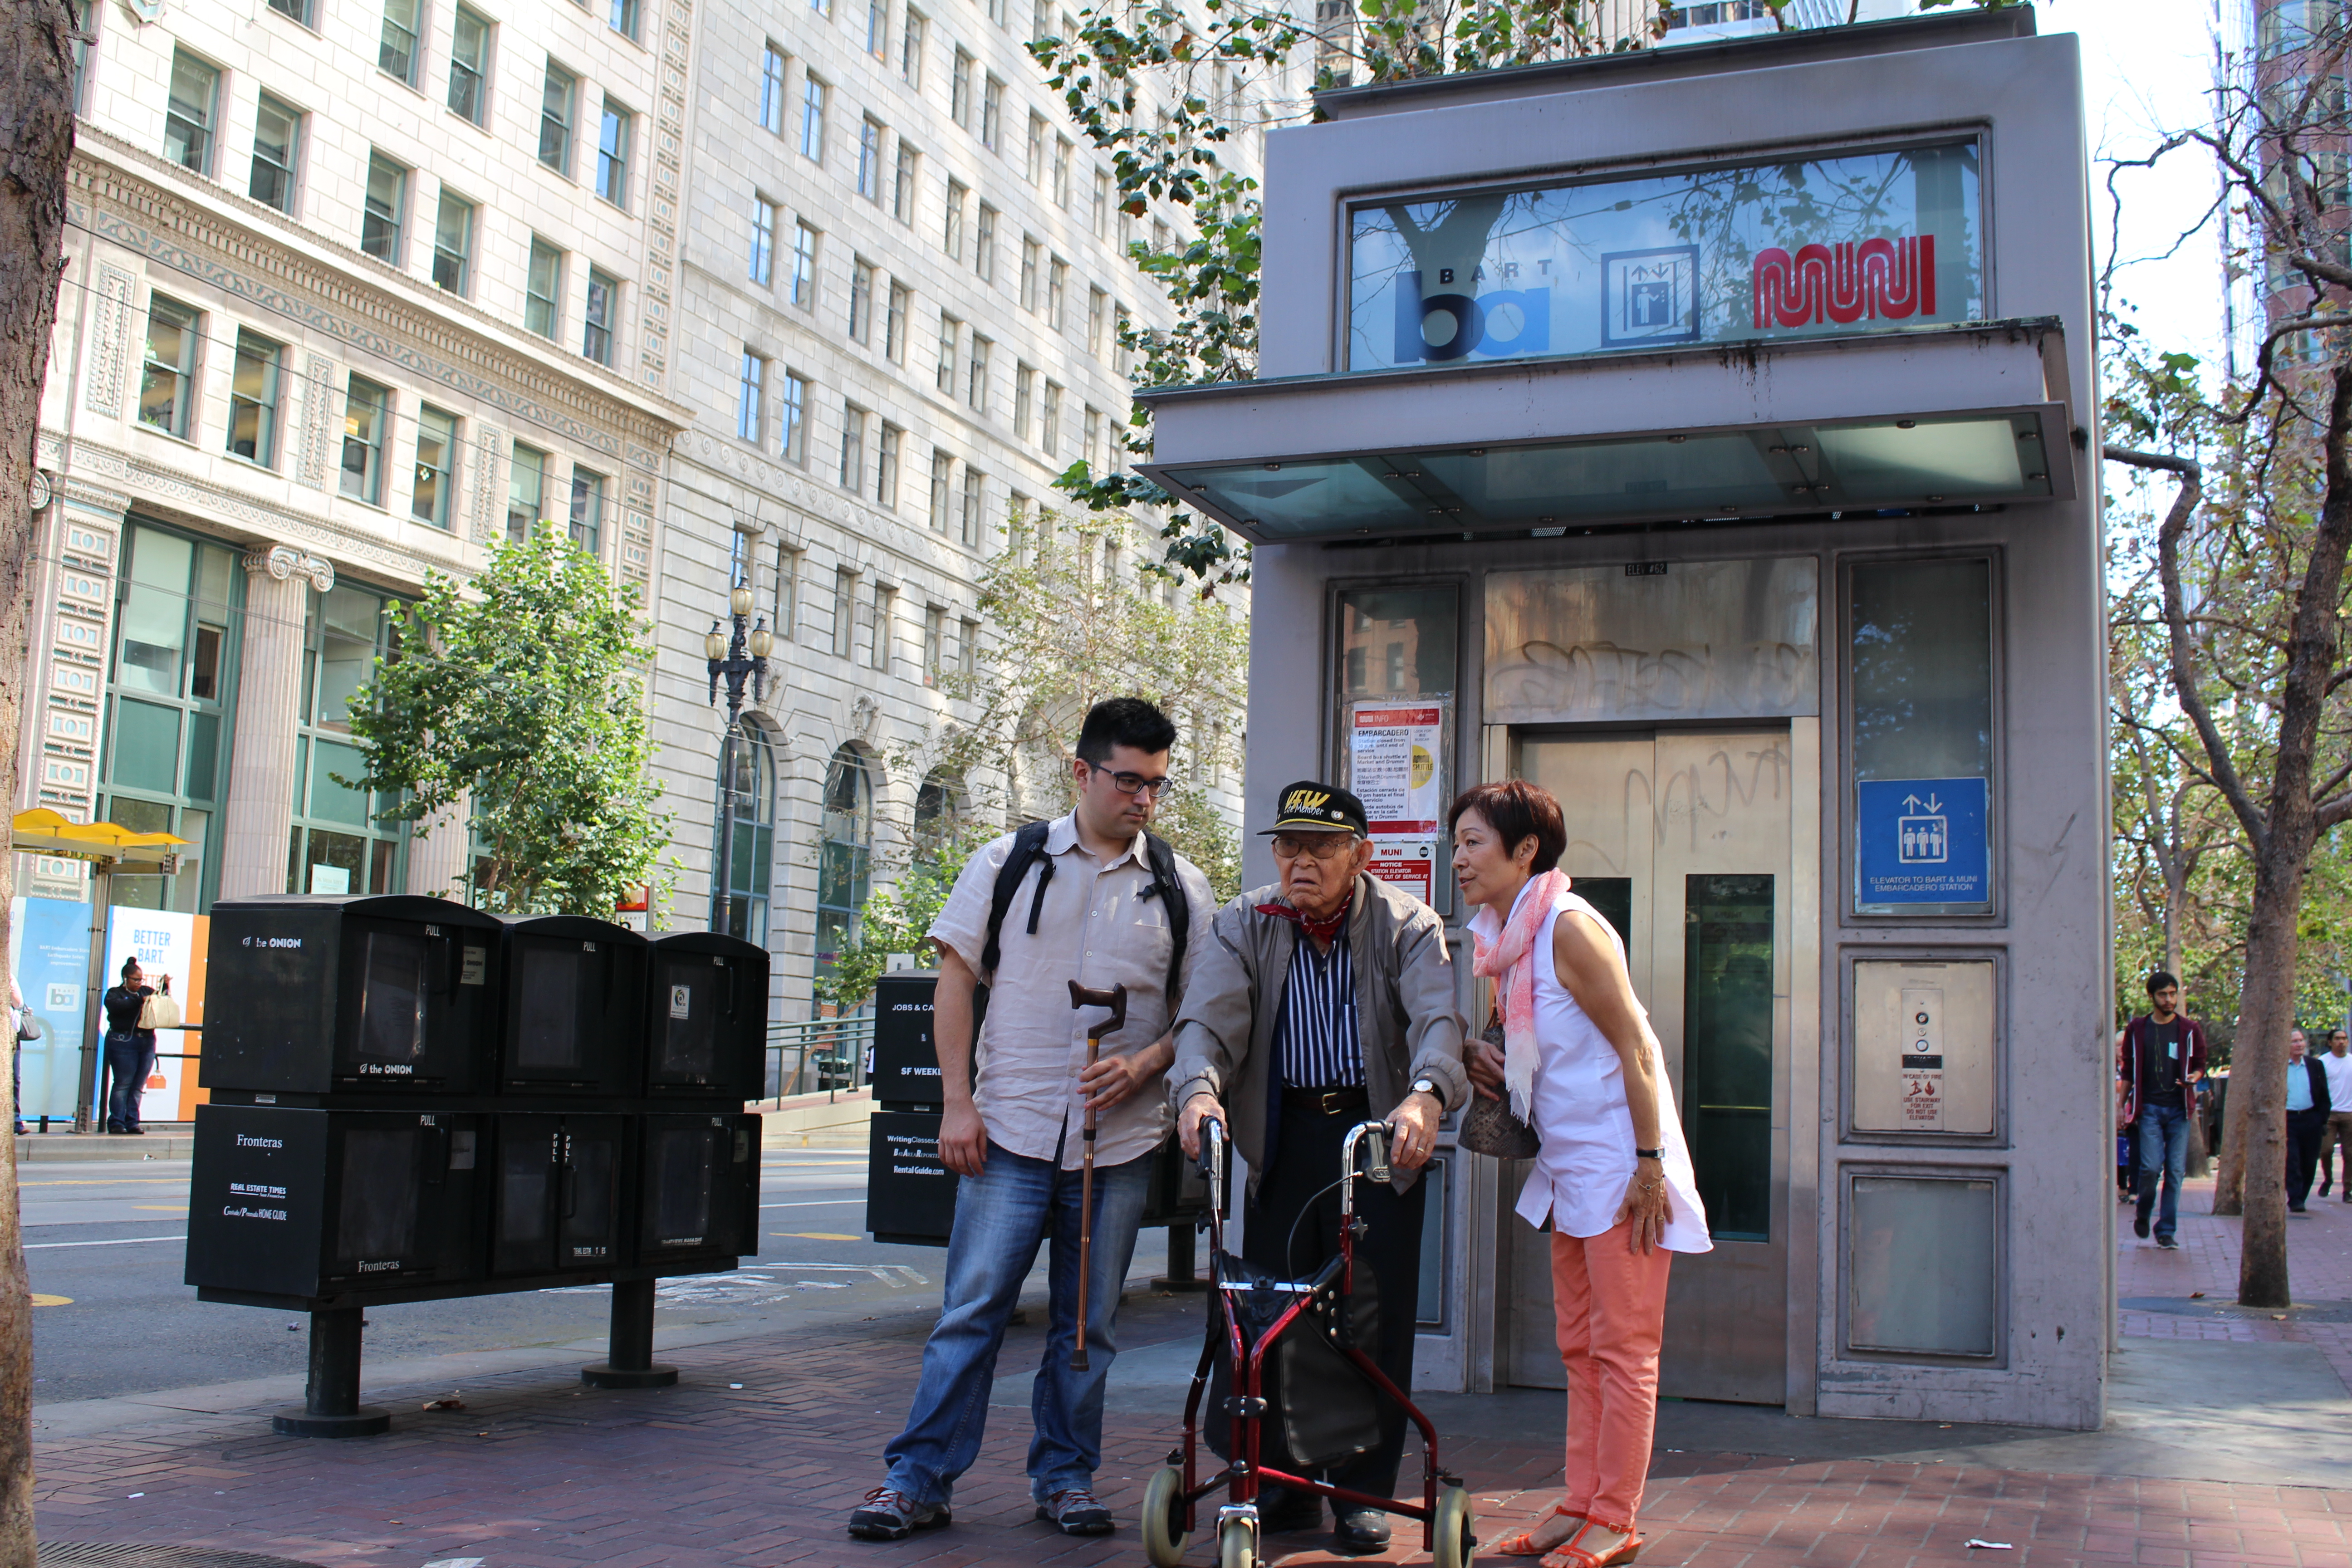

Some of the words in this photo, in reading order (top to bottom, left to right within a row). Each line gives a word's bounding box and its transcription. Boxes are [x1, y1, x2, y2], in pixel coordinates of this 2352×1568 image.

[1440, 259, 1552, 284] BART
[1628, 564, 1646, 575] ELEV
[1374, 715, 1389, 723] INFO
[1358, 729, 1409, 737] EMBARCADERO
[1285, 789, 1331, 810] VFW
[1294, 802, 1324, 815] Member
[1875, 884, 1937, 892] EMBARCADERO
[426, 925, 440, 936] PULL
[134, 929, 171, 946] BETTER
[269, 938, 301, 948] ONION
[583, 941, 596, 951] PULL
[137, 948, 164, 964] BART.
[713, 956, 724, 965] PULL
[369, 1063, 382, 1073] the
[385, 1064, 412, 1074] ONION
[901, 1067, 912, 1075] SF
[914, 1068, 942, 1076] WEEKL
[420, 1115, 435, 1126] PULL
[711, 1117, 722, 1126] PULL
[237, 1134, 283, 1148] Fronteras
[230, 1183, 245, 1191] REAL
[246, 1184, 268, 1193] ESTATE
[269, 1186, 287, 1195] TIMES
[259, 1208, 273, 1220] HOME
[273, 1210, 287, 1221] GUIDE
[358, 1261, 400, 1272] Fronteras
